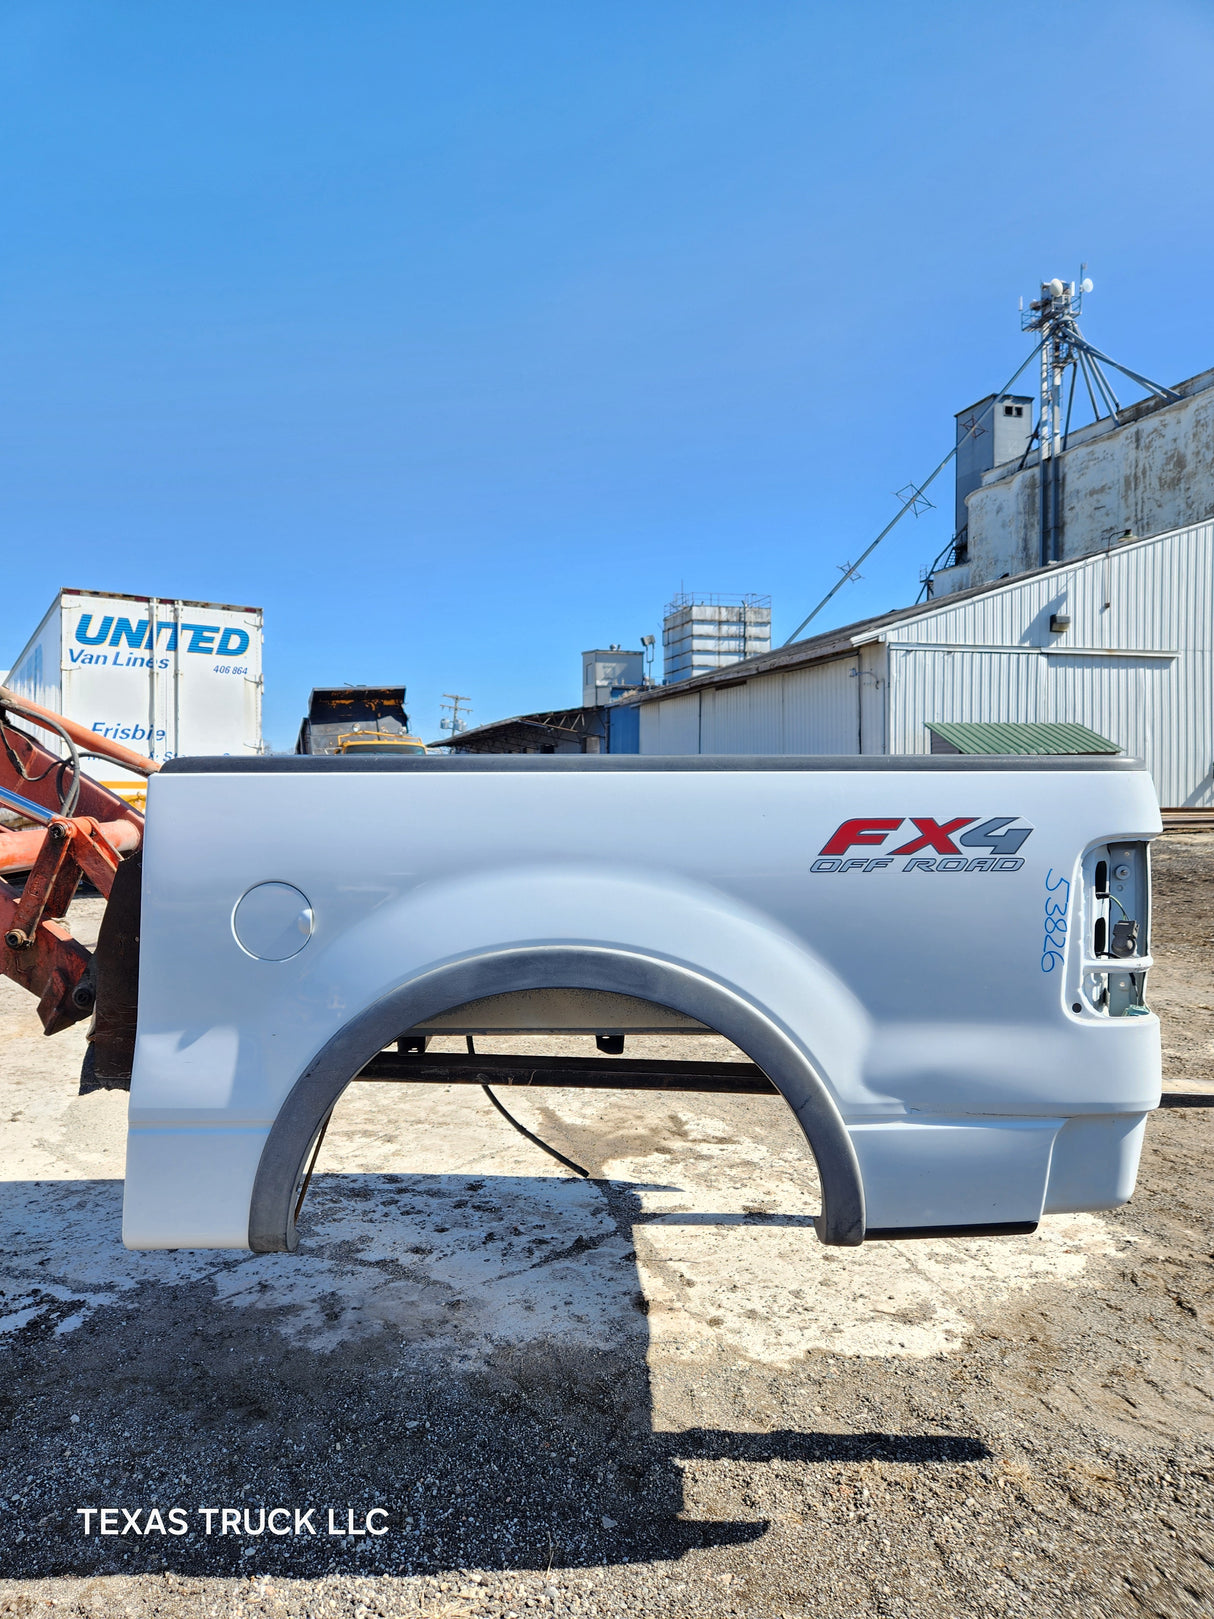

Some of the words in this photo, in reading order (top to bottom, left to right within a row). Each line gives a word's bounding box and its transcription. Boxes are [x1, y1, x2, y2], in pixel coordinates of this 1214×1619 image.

[74, 613, 250, 657] UNITED
[68, 648, 107, 666] Van
[111, 654, 170, 669] Lines
[213, 664, 231, 674] 406
[231, 666, 248, 675] 864
[91, 721, 166, 741] Frisbie
[817, 817, 1034, 856] FX4
[810, 857, 894, 873] OFF
[902, 857, 1026, 873] ROAD
[1041, 868, 1070, 973] 53826
